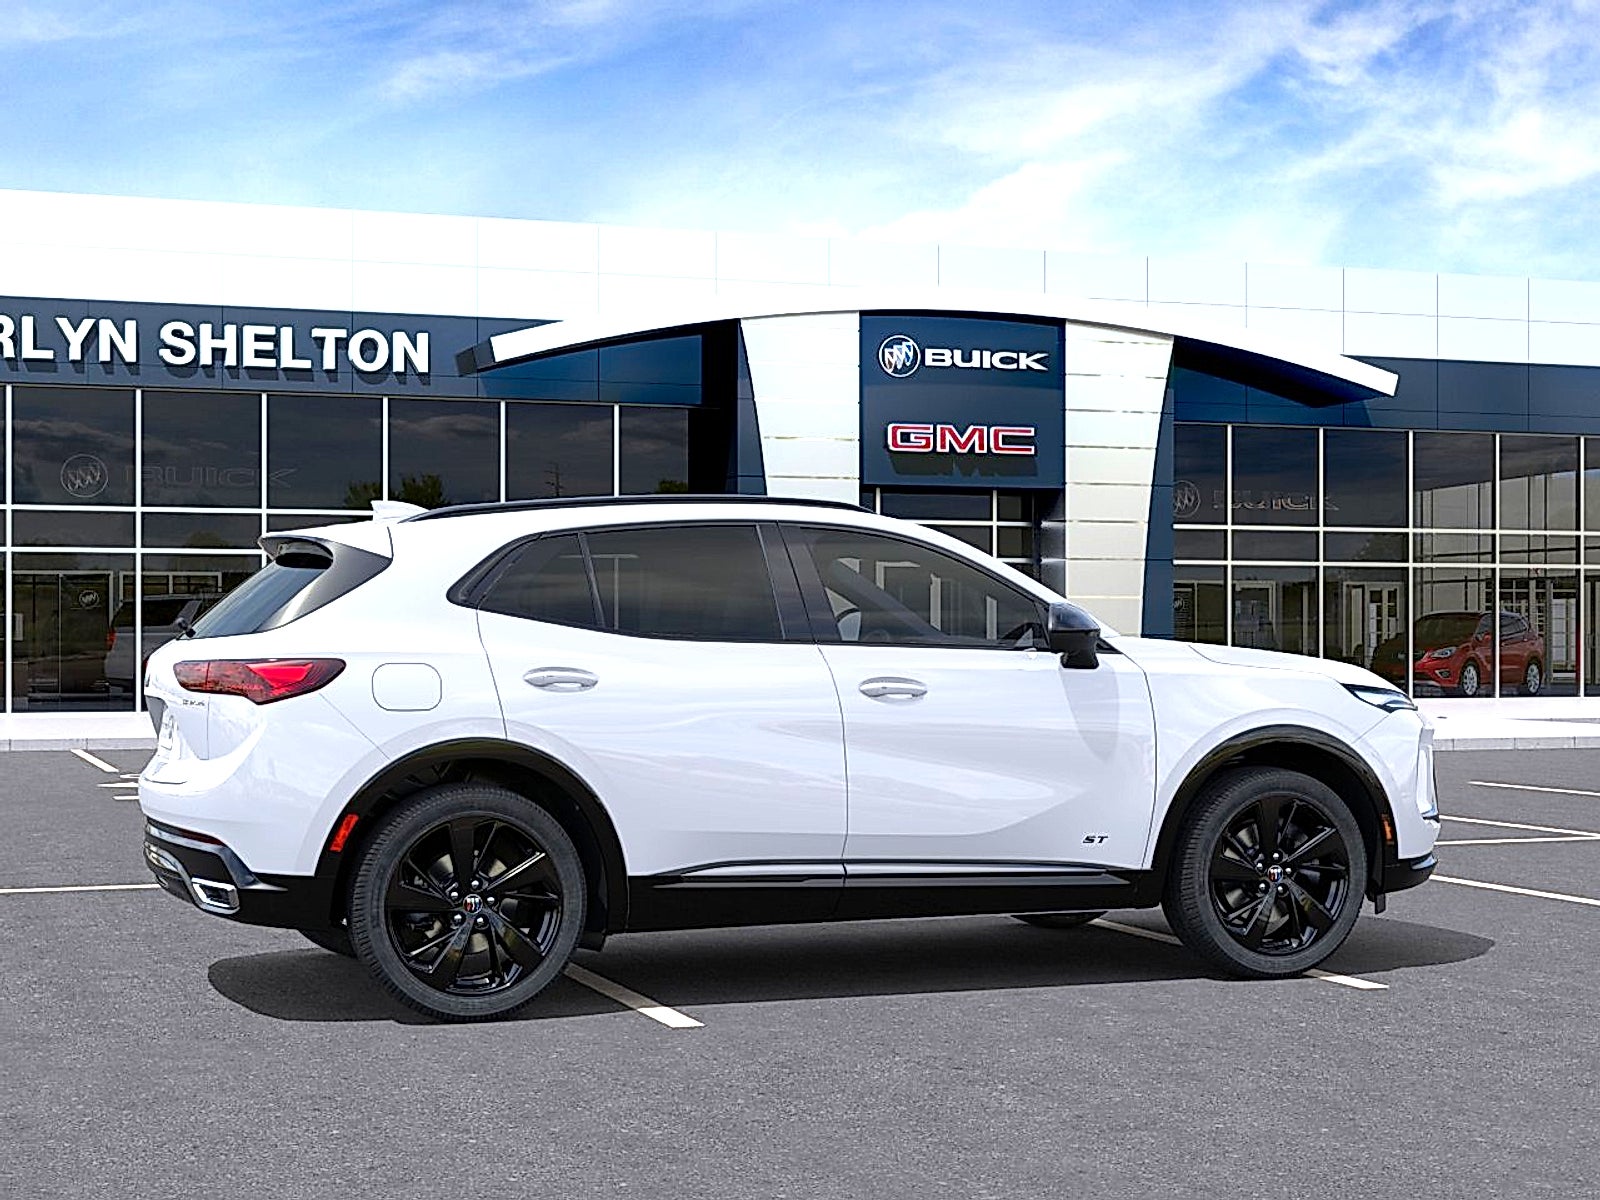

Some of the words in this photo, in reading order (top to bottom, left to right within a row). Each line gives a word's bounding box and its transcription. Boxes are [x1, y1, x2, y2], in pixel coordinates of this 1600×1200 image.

[158, 320, 431, 374] SHELTON
[924, 348, 1049, 371] BUICK
[887, 423, 1036, 455] GMC
[1082, 835, 1109, 844] ST
